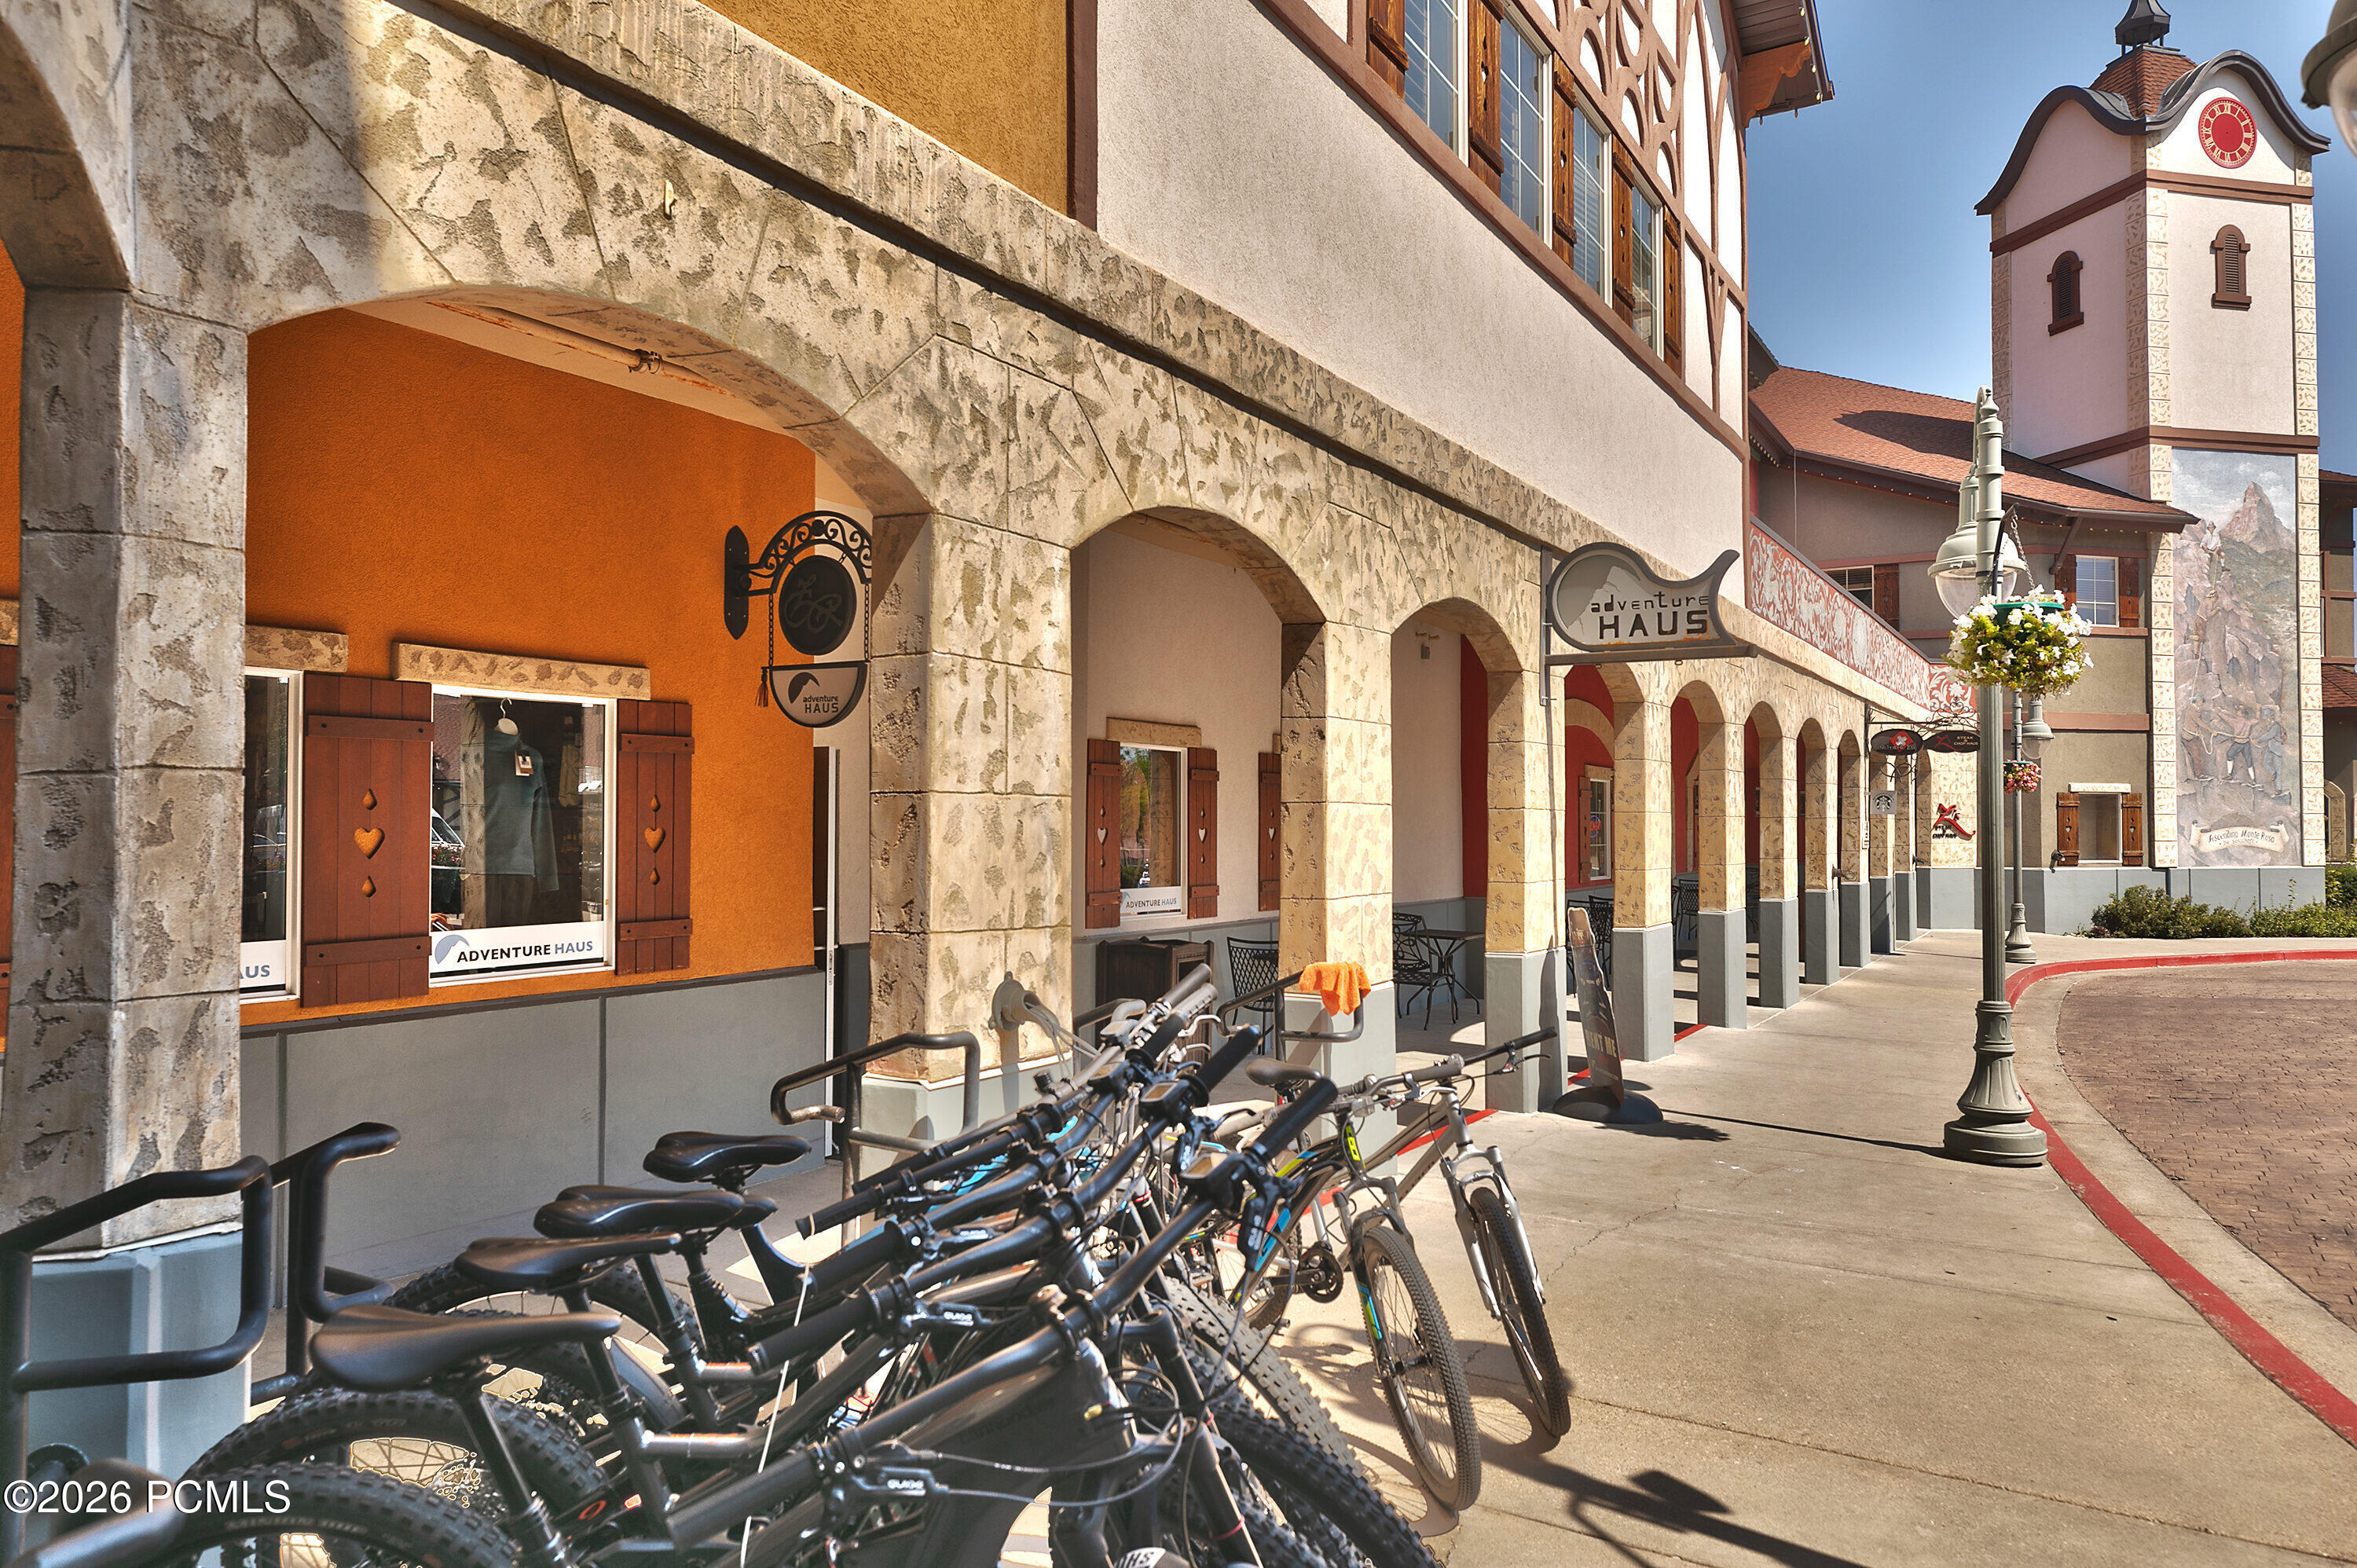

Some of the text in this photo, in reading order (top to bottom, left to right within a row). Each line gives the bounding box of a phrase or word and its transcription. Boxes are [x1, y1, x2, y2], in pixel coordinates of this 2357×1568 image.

[1591, 591, 1710, 613] adventure
[1599, 610, 1708, 639] HAUS
[805, 703, 838, 713] HAUS
[2242, 830, 2260, 839] Monte
[2261, 832, 2275, 843] Rosa
[1126, 899, 1160, 908] ADVENTURE
[456, 940, 593, 963] ADVENTURE HAUS
